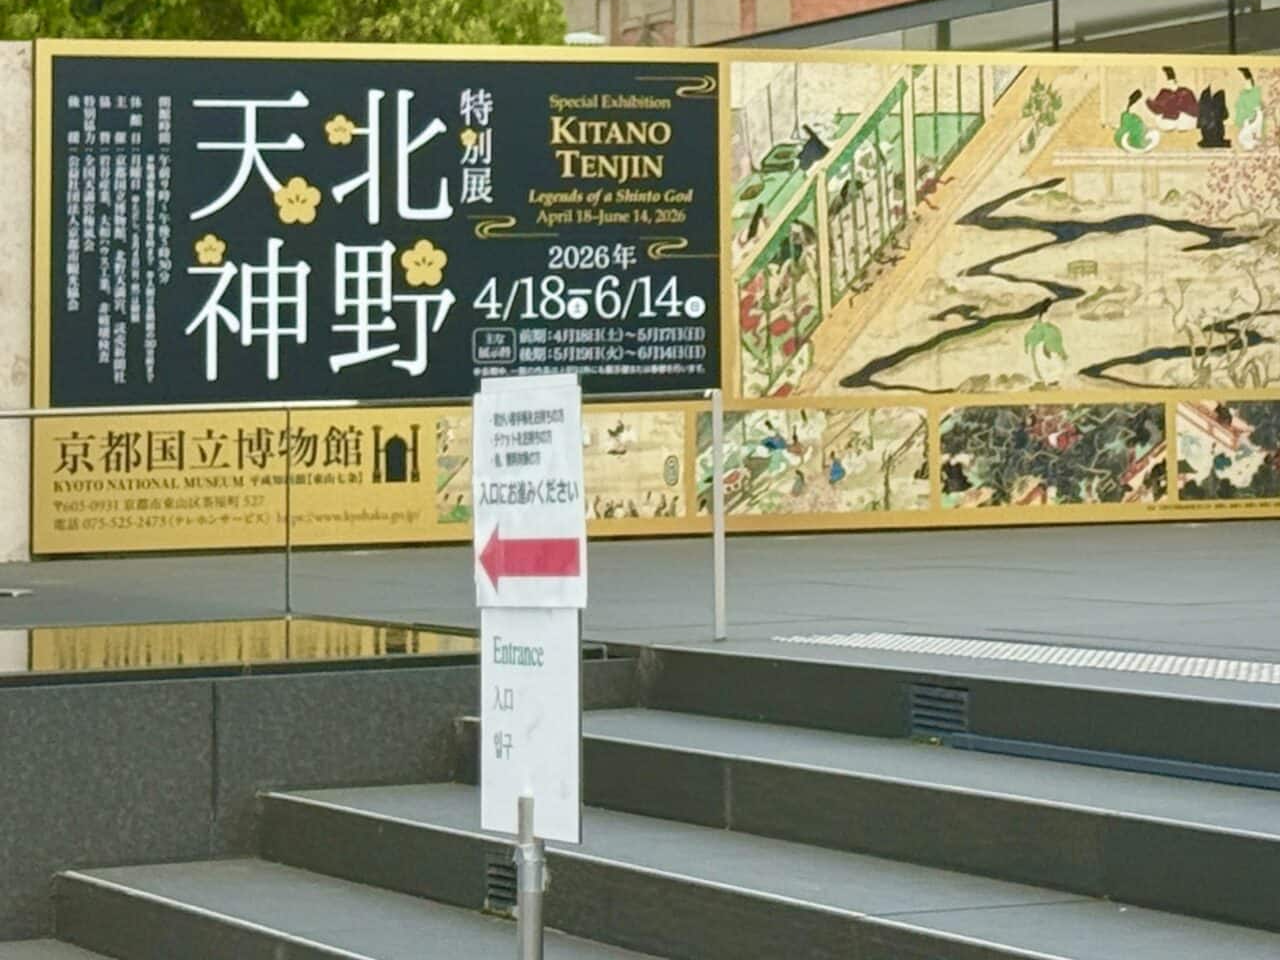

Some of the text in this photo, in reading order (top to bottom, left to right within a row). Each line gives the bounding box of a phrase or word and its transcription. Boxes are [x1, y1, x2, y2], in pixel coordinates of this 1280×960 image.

[549, 94, 672, 112] Special Exhibition
[551, 116, 672, 145] KITANO
[460, 88, 494, 204] 特別展
[555, 150, 664, 184] TENJIN
[528, 189, 693, 205] Legends of a Shinto God
[536, 209, 573, 226] April
[633, 208, 652, 225] 14,
[655, 208, 687, 223] 2026
[548, 244, 638, 270] 2026年
[53, 425, 364, 474] 京都国立博物館
[53, 480, 104, 494] KYOTO
[107, 478, 180, 492] NATIONAL
[184, 476, 244, 490] MUSEUM
[479, 479, 579, 506] 入口にお進みください
[493, 636, 545, 667] Entrance
[494, 684, 515, 712] 入口
